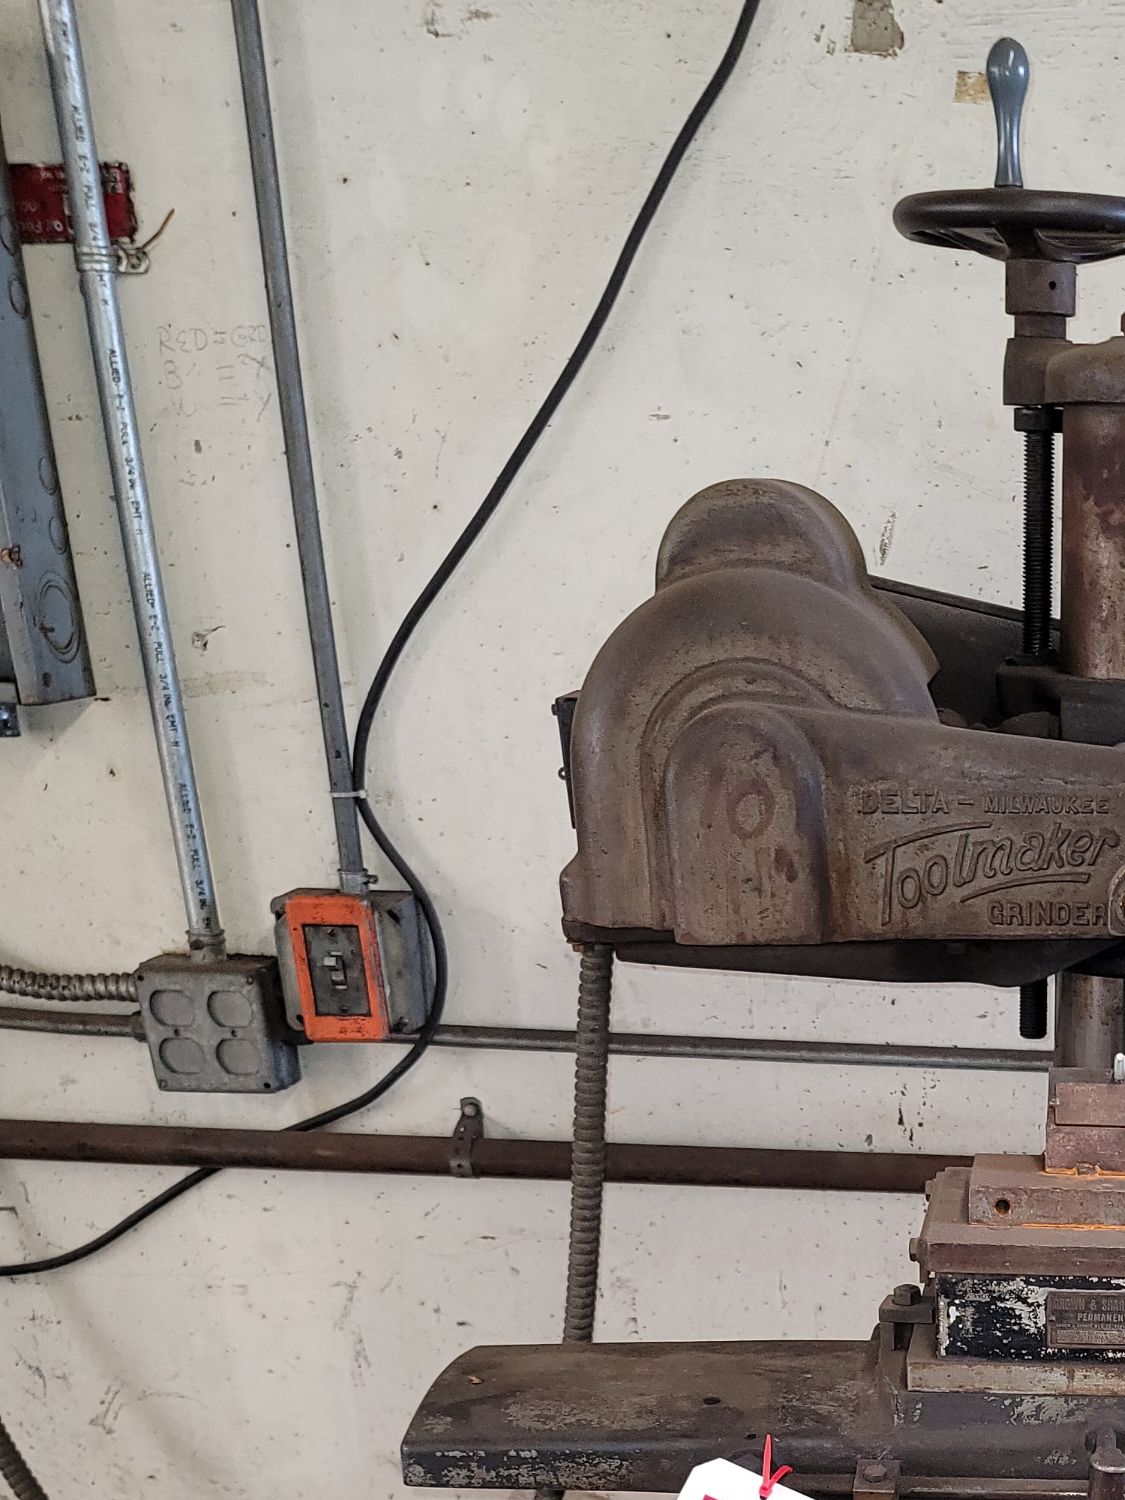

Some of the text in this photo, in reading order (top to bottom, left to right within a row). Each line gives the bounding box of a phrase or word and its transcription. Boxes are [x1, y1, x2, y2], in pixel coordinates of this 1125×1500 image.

[858, 789, 950, 815] DELTA
[984, 795, 1111, 815] MILWAUKEE
[864, 821, 1121, 927] Toolmaker
[986, 900, 1109, 926] GRINDER
